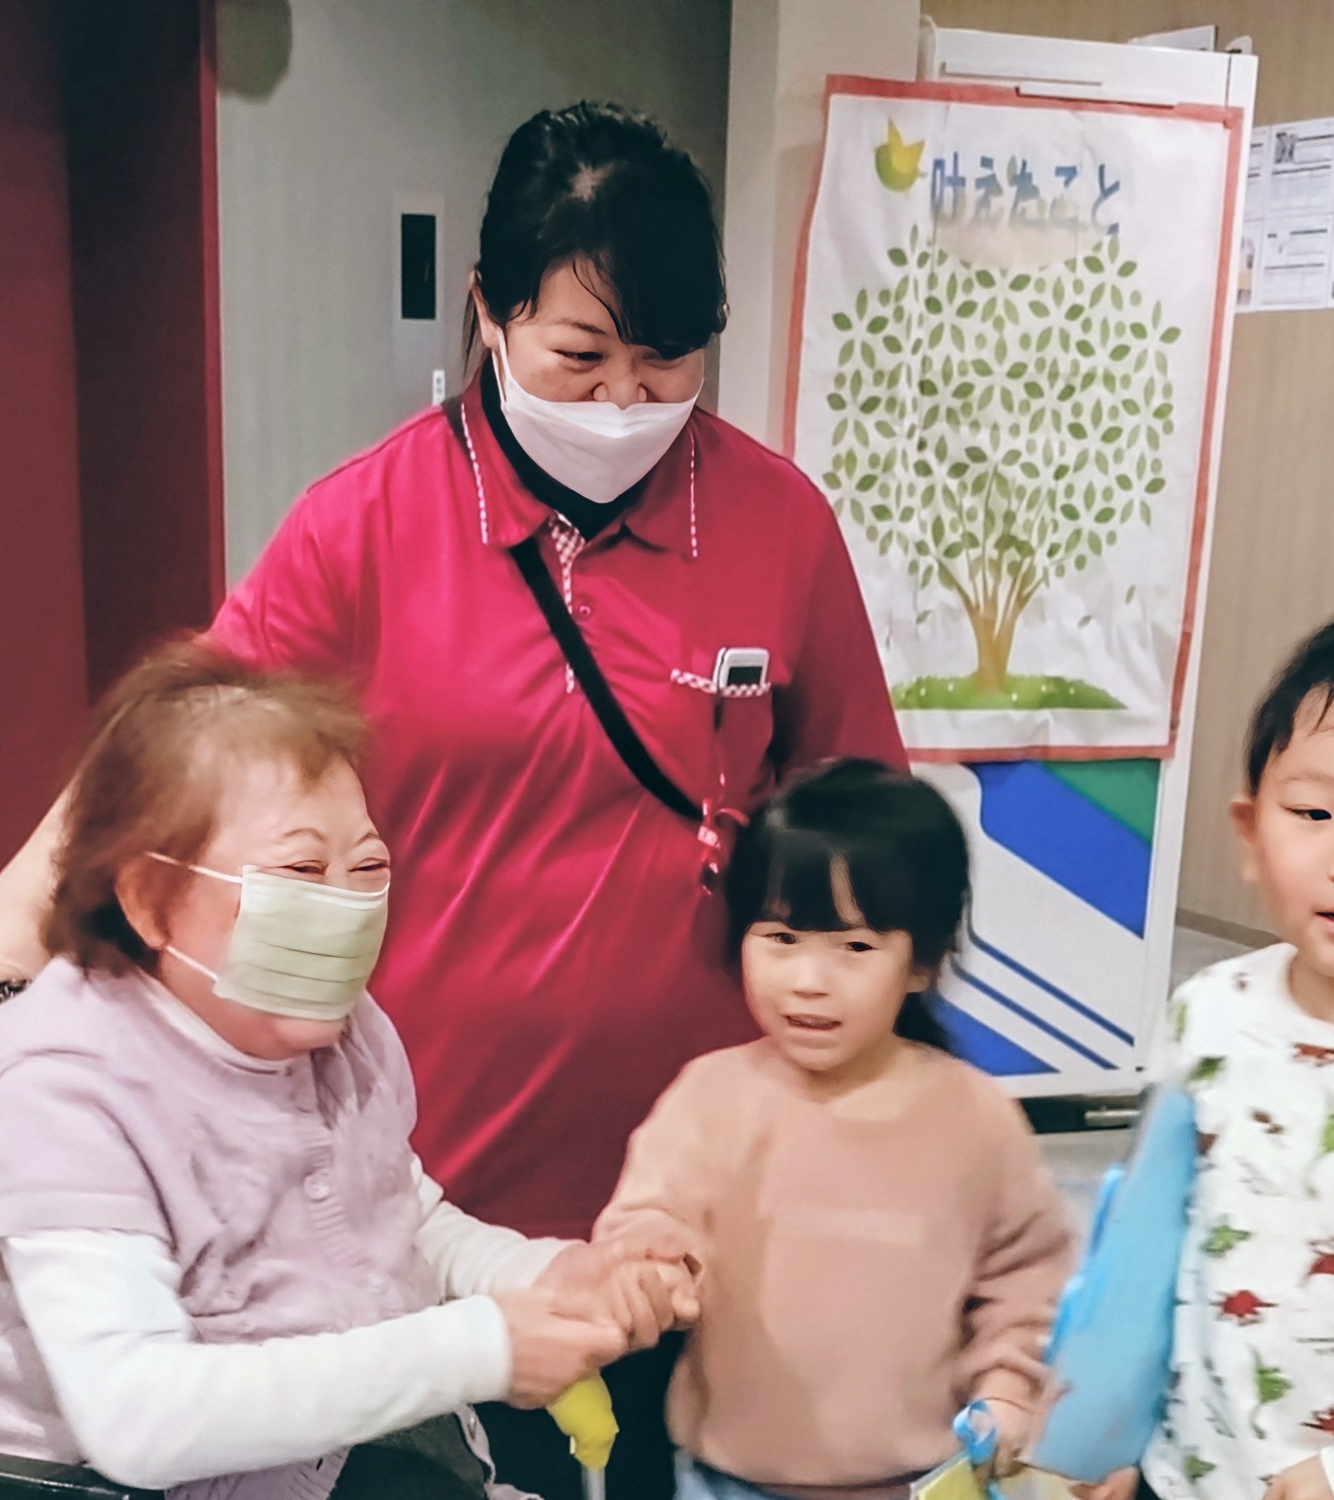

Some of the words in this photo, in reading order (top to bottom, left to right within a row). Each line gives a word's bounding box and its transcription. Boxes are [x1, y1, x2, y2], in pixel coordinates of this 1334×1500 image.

[930, 151, 1122, 232] 叶えたこと
